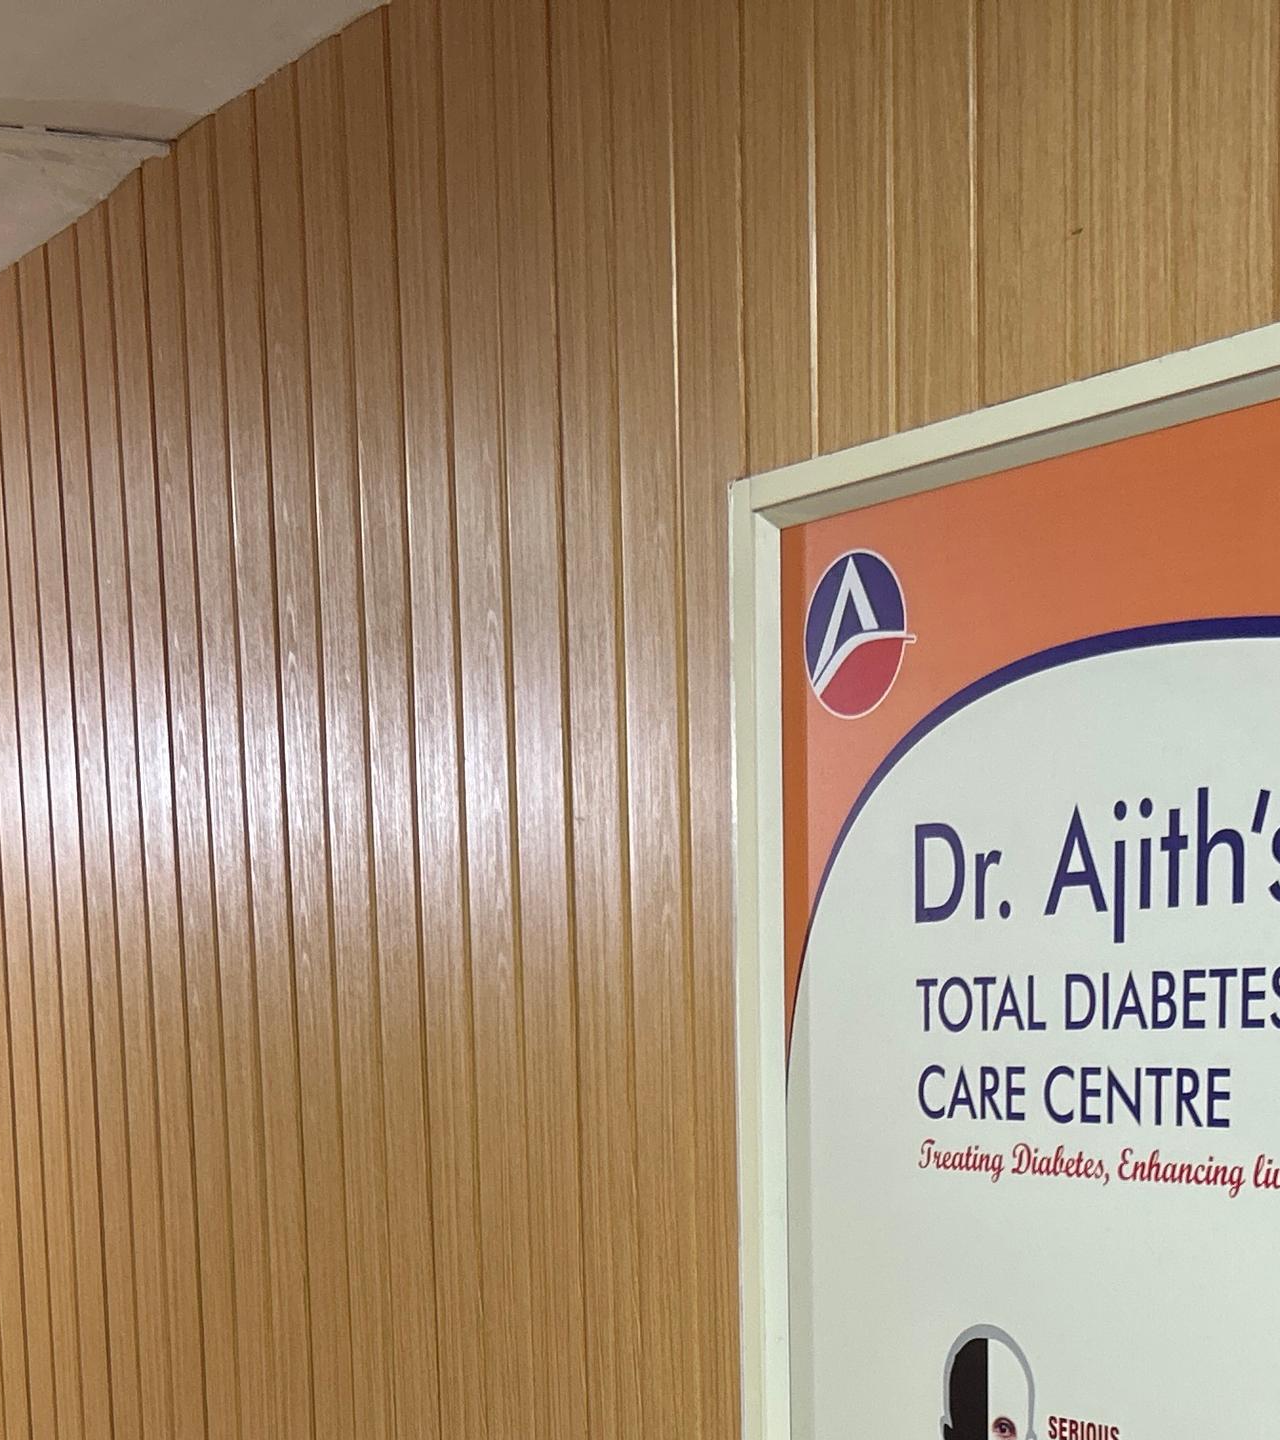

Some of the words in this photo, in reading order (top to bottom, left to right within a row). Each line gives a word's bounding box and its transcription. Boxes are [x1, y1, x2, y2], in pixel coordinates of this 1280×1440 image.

[914, 822, 1013, 924] Dr.
[916, 973, 1047, 1033] TOTAL
[918, 1064, 1026, 1121] CARE
[1043, 1064, 1231, 1128] CENTRE
[918, 1138, 1005, 1182] Treating
[1010, 1144, 1111, 1187] Diabetes,
[1117, 1147, 1246, 1199] Enhancing
